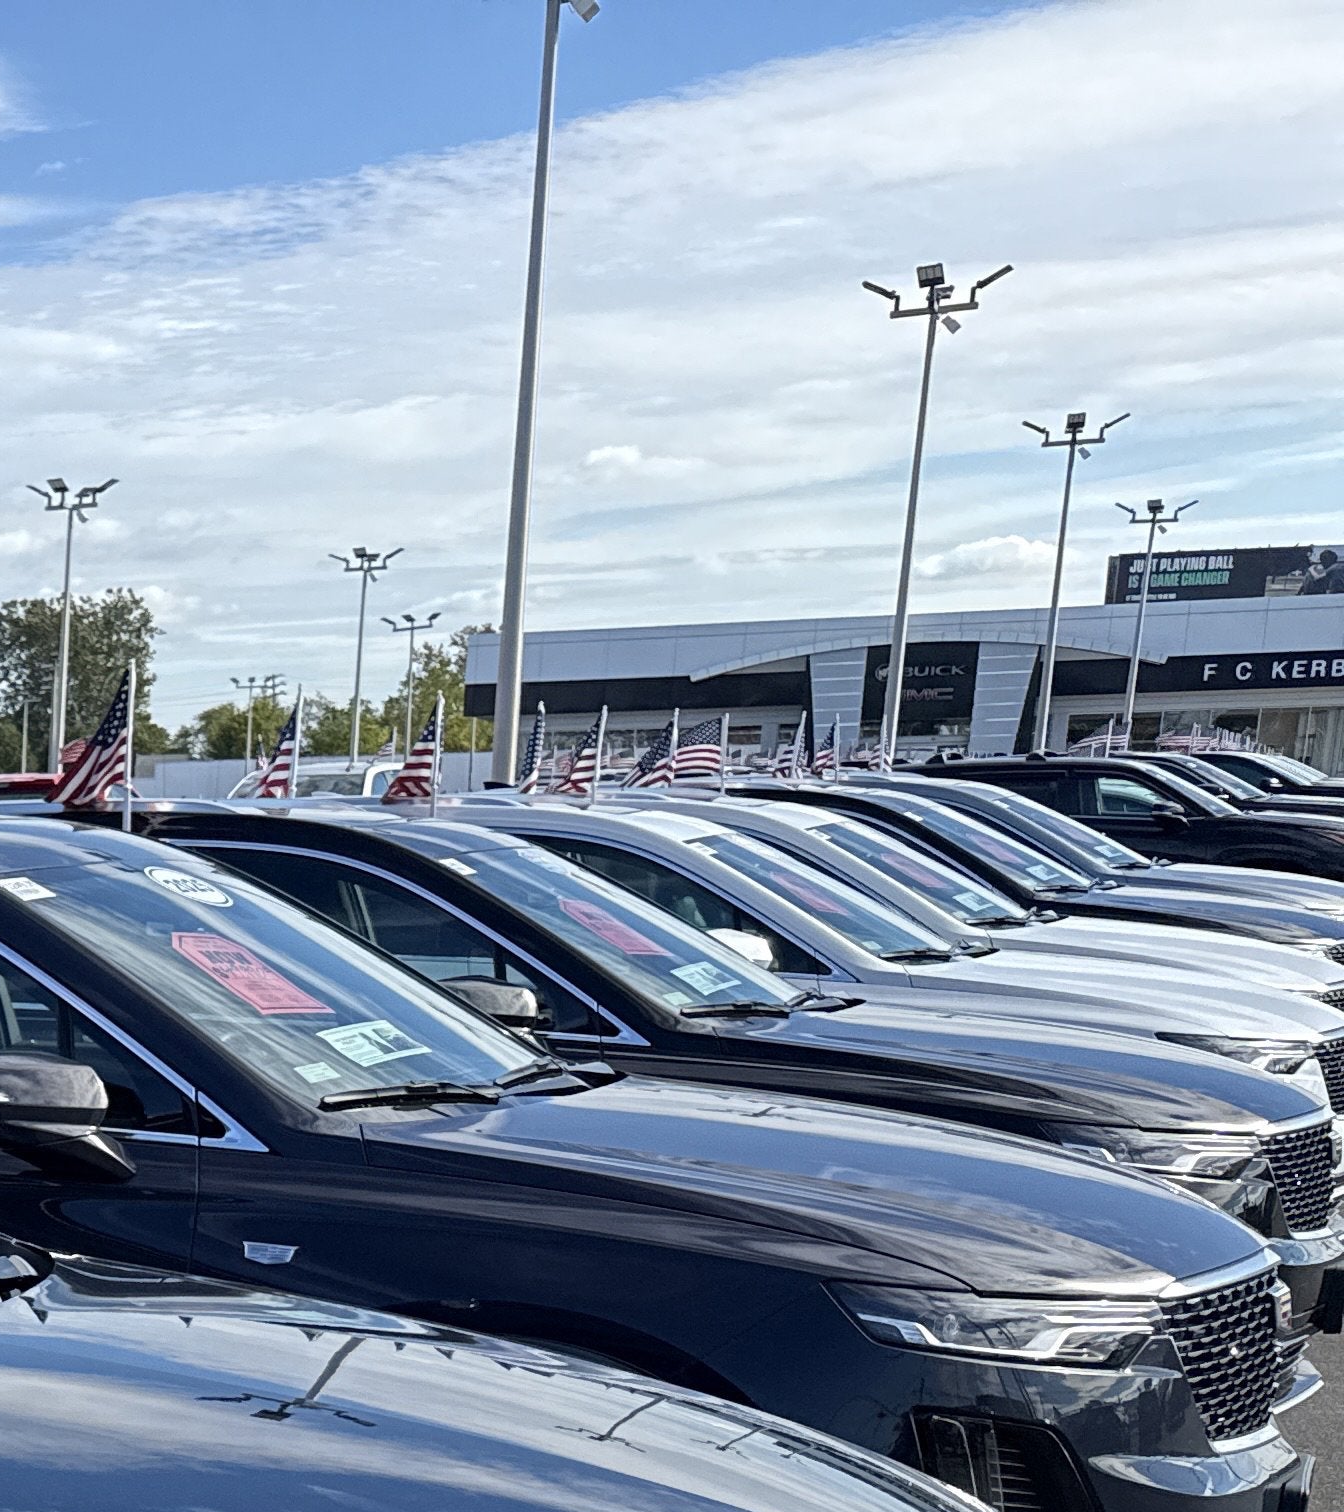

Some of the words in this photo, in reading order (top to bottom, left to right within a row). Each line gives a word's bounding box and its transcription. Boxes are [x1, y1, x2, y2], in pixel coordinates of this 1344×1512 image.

[1129, 558, 1159, 574] JUT
[1159, 556, 1207, 572] PLAYING
[1208, 555, 1234, 569] BALL
[1128, 574, 1139, 588] IS
[1150, 572, 1180, 587] GAME
[1181, 571, 1230, 586] CHANGER
[1202, 663, 1218, 682] F
[1235, 661, 1252, 681] C
